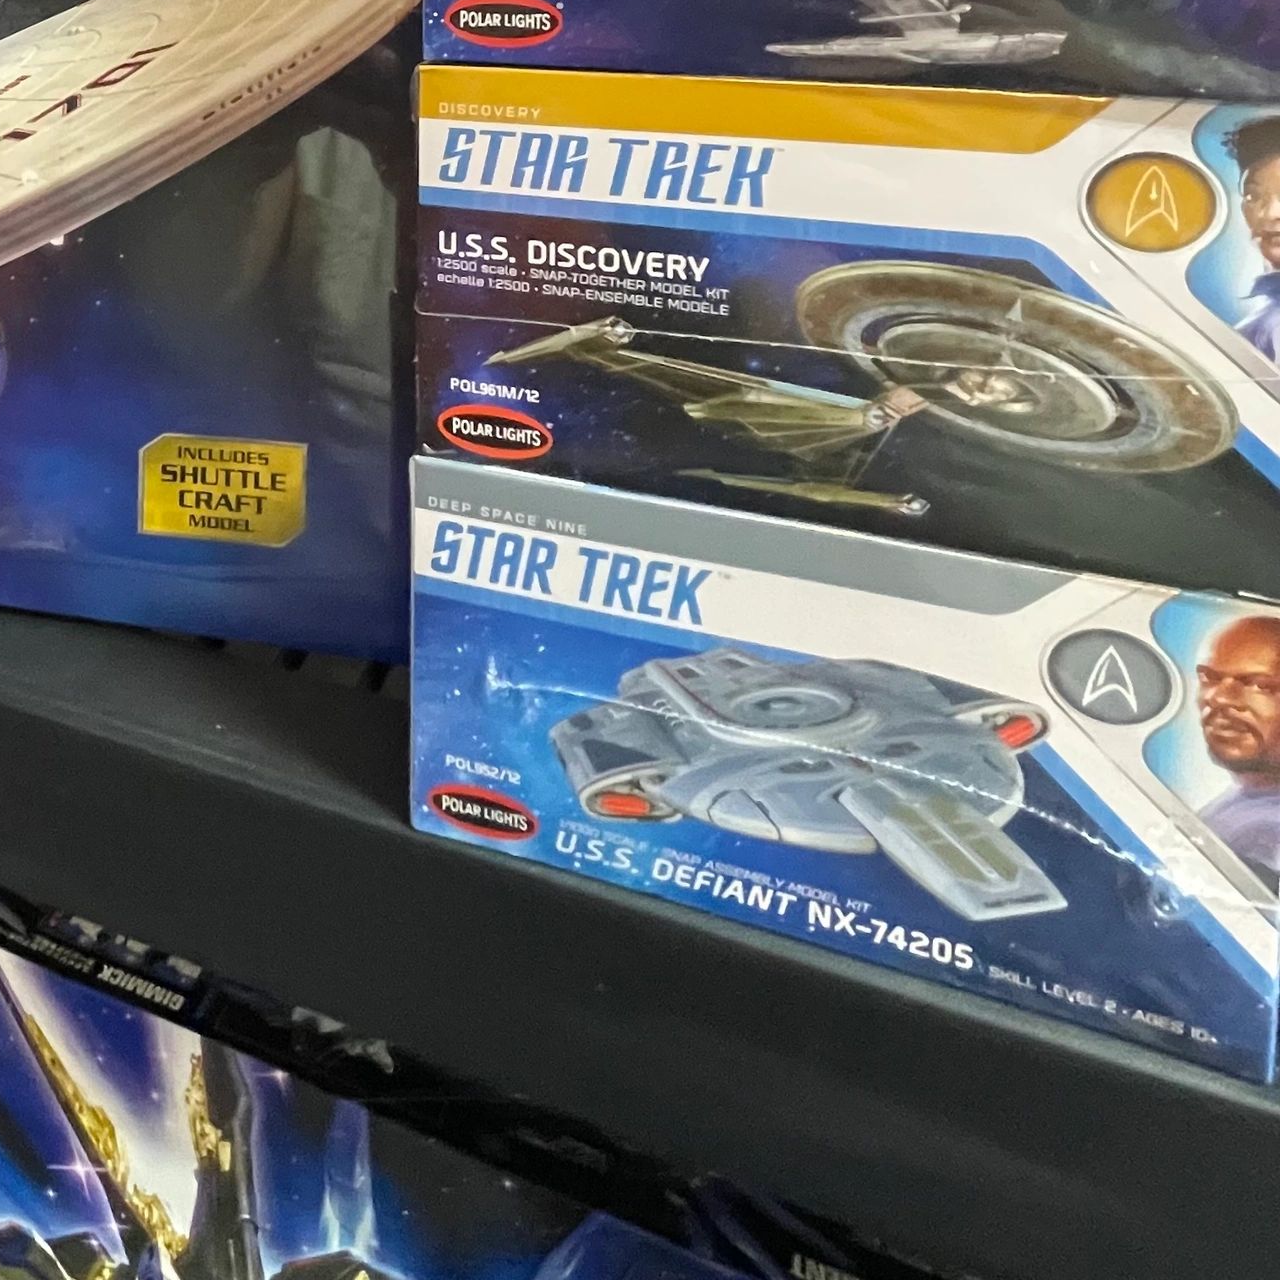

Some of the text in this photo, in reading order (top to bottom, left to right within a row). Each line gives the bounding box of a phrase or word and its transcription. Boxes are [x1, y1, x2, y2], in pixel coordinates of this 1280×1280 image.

[459, 9, 552, 32] POLAR LIGHTS
[438, 101, 542, 120] DISCOVERY
[438, 126, 776, 209] STAR TREK
[437, 229, 711, 283] U.S.S. DISCOVERY
[436, 273, 485, 289] echelle
[541, 283, 664, 310] SNAP-ENSEMBLE
[480, 261, 518, 278] scale
[529, 268, 647, 293] SNAP-TOGETHER
[650, 281, 702, 298] MODEL
[705, 286, 731, 301] KIT
[450, 376, 540, 404] POL961M/12
[451, 417, 542, 447] POLAR LIGHTS
[177, 445, 270, 467] INCLUDES
[160, 463, 287, 493] SHUTTLE
[178, 489, 268, 516] CRAFT
[428, 495, 588, 537] DEEP SPACE NINE
[188, 513, 256, 534] MODEL
[430, 519, 713, 626] STAR TREK
[441, 794, 528, 832] POLAR LIGHTS
[555, 829, 975, 970] U.S.S. DEFIANT NX-74205
[845, 898, 873, 914] KIT
[96, 963, 186, 1012] GIMMICK
[988, 965, 1186, 1035] SKILL LEVEL 2 AGES
